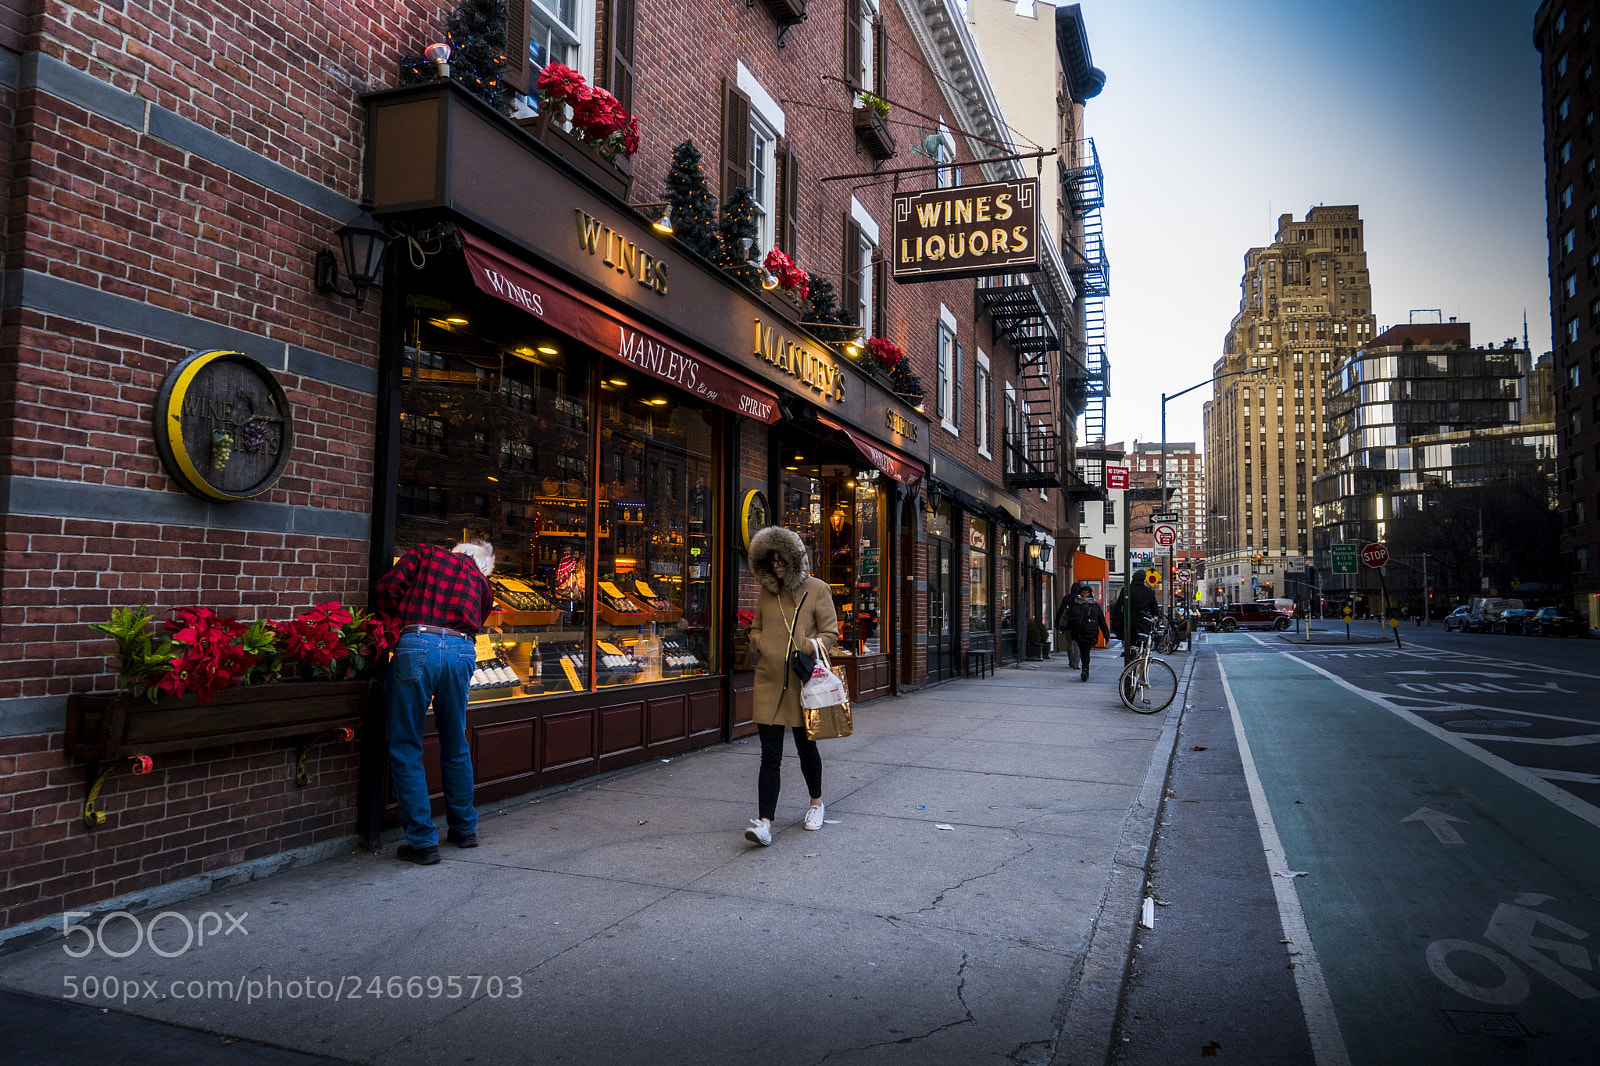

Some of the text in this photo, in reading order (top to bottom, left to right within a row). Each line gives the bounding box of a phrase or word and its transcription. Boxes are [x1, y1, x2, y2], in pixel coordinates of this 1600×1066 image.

[915, 193, 1013, 228] WINES
[575, 207, 669, 296] WINES
[901, 226, 1029, 263] LIQUORS
[484, 268, 544, 316] WINES
[618, 326, 699, 389] MANLEY'S
[738, 394, 772, 420] SPIRITS
[753, 317, 846, 404] MANLEY'S
[183, 396, 233, 423] WINE
[886, 407, 918, 442] SPIRITS
[1130, 551, 1153, 559] Mobil
[1363, 549, 1387, 562] STOP
[1396, 682, 1579, 694] ONLY
